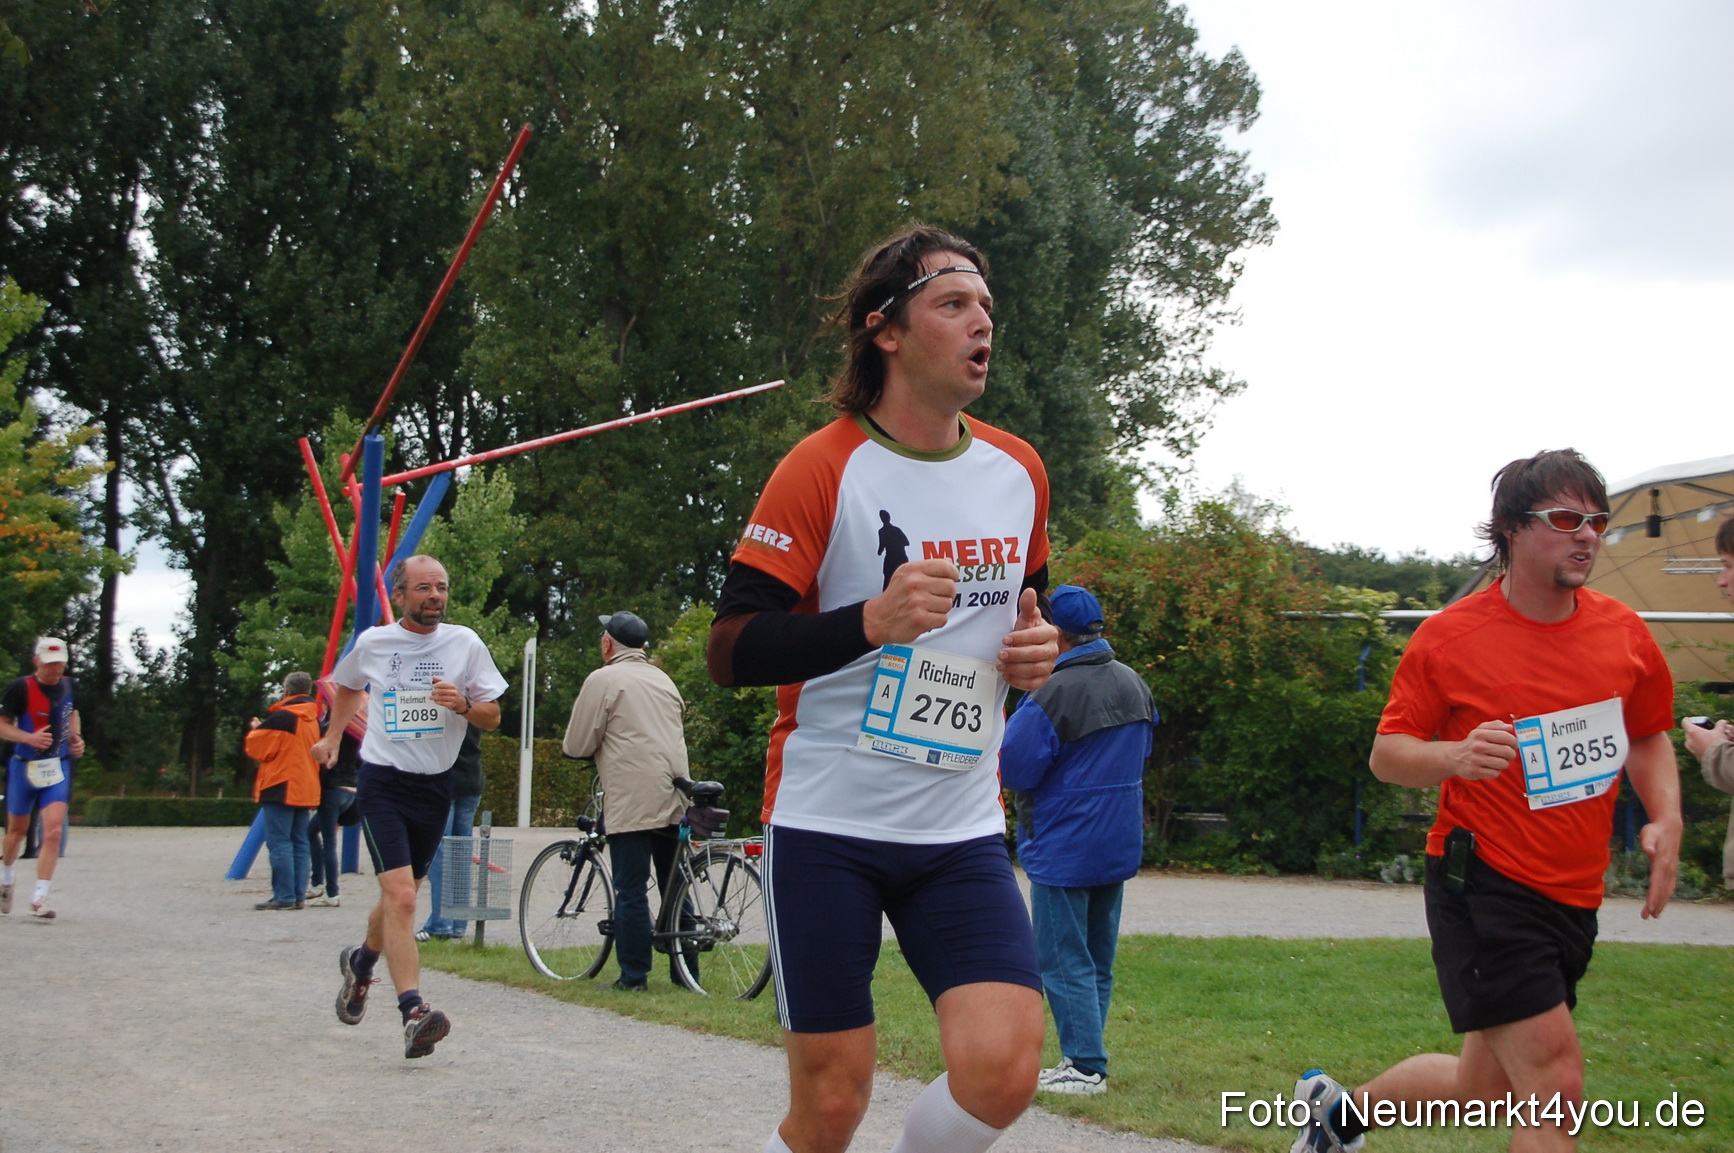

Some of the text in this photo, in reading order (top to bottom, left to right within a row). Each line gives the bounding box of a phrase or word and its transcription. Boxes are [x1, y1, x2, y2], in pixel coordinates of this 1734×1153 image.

[922, 537, 1021, 566] MERZ
[956, 557, 1006, 583] isen
[967, 590, 1009, 608] 2008
[918, 659, 977, 690] Richard
[400, 696, 426, 704] Helmut
[881, 684, 890, 699] A
[401, 708, 438, 722] 2089
[909, 693, 982, 733] 2763
[1551, 717, 1587, 738] Armin
[941, 751, 980, 765] PFLEIDERER
[1530, 752, 1538, 764] A
[1557, 735, 1617, 771] 2855
